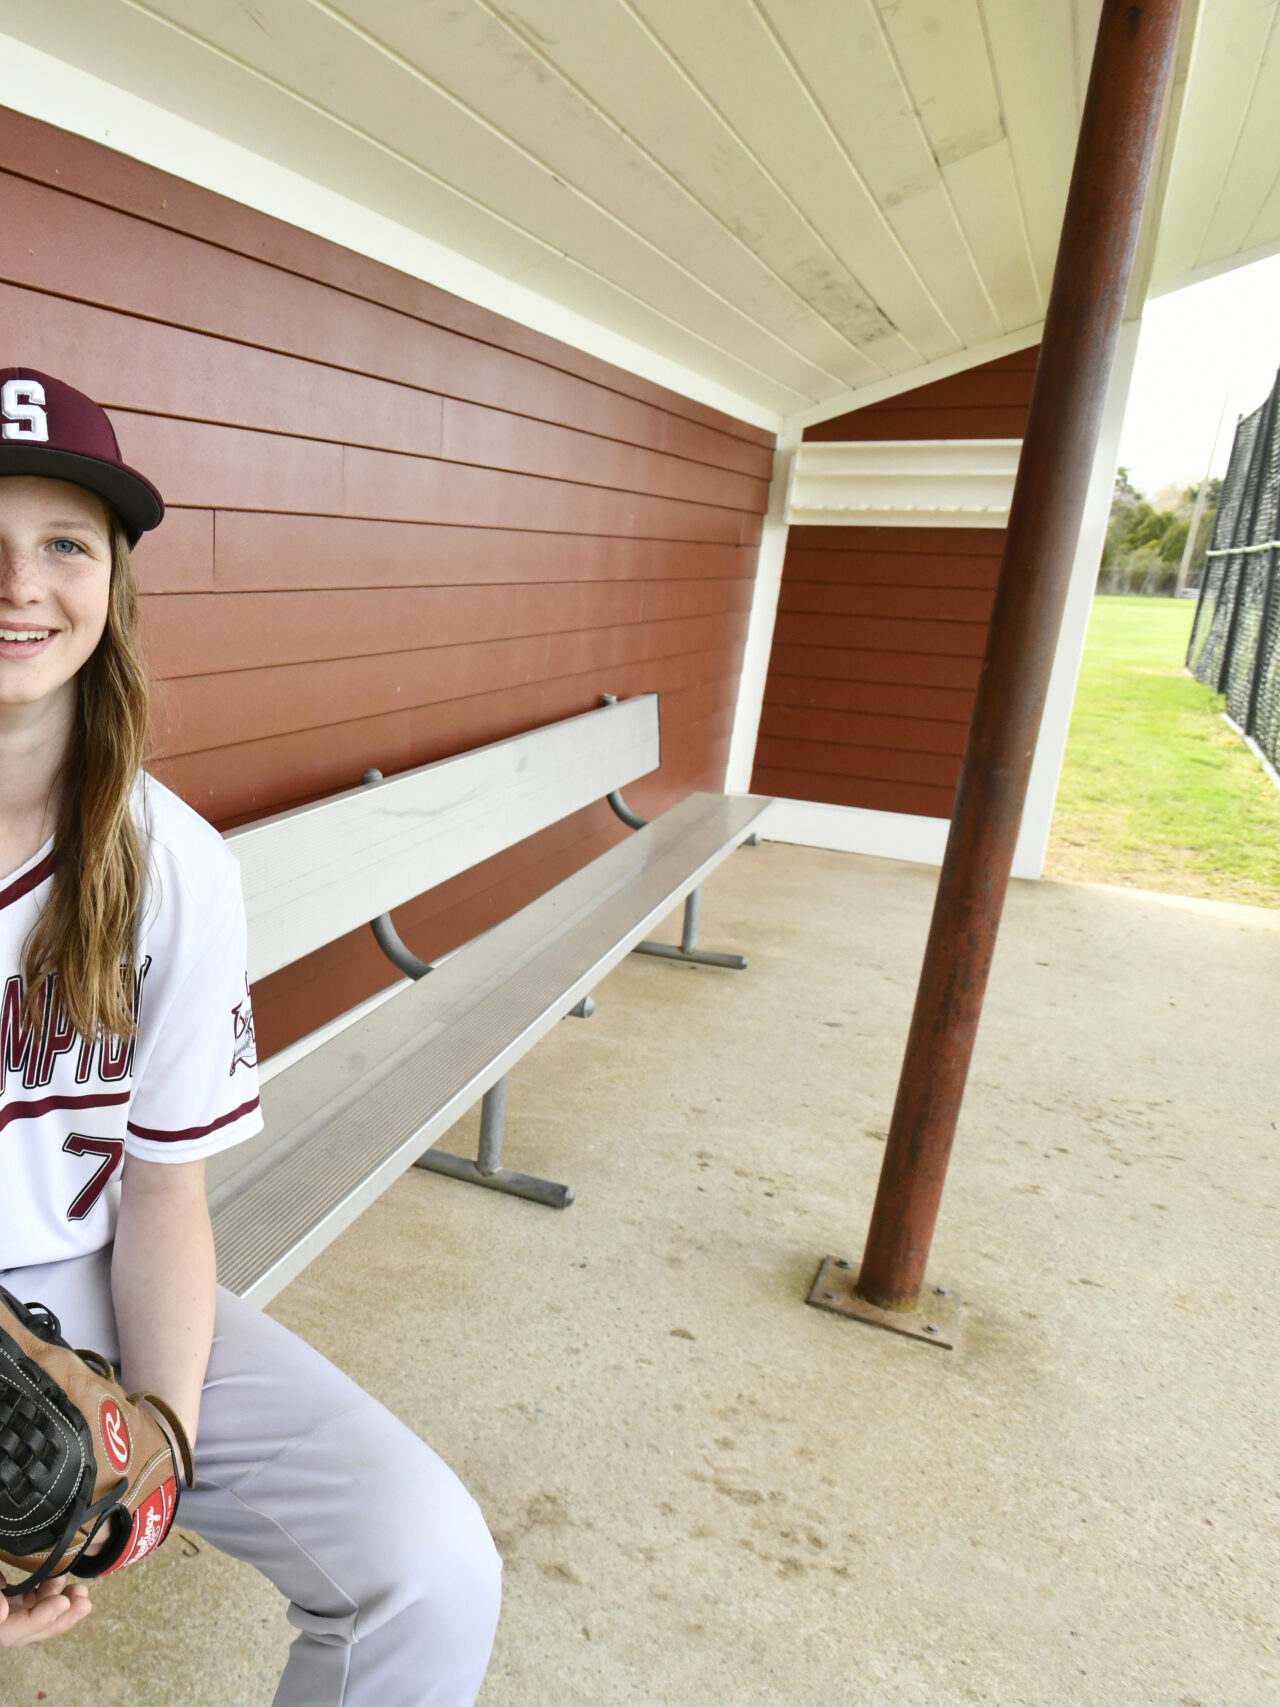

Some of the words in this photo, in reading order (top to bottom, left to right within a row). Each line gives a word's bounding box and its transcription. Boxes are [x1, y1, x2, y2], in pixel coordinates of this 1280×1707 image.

[1, 379, 49, 442] S
[62, 1132, 124, 1221] 7
[105, 1408, 127, 1463] R
